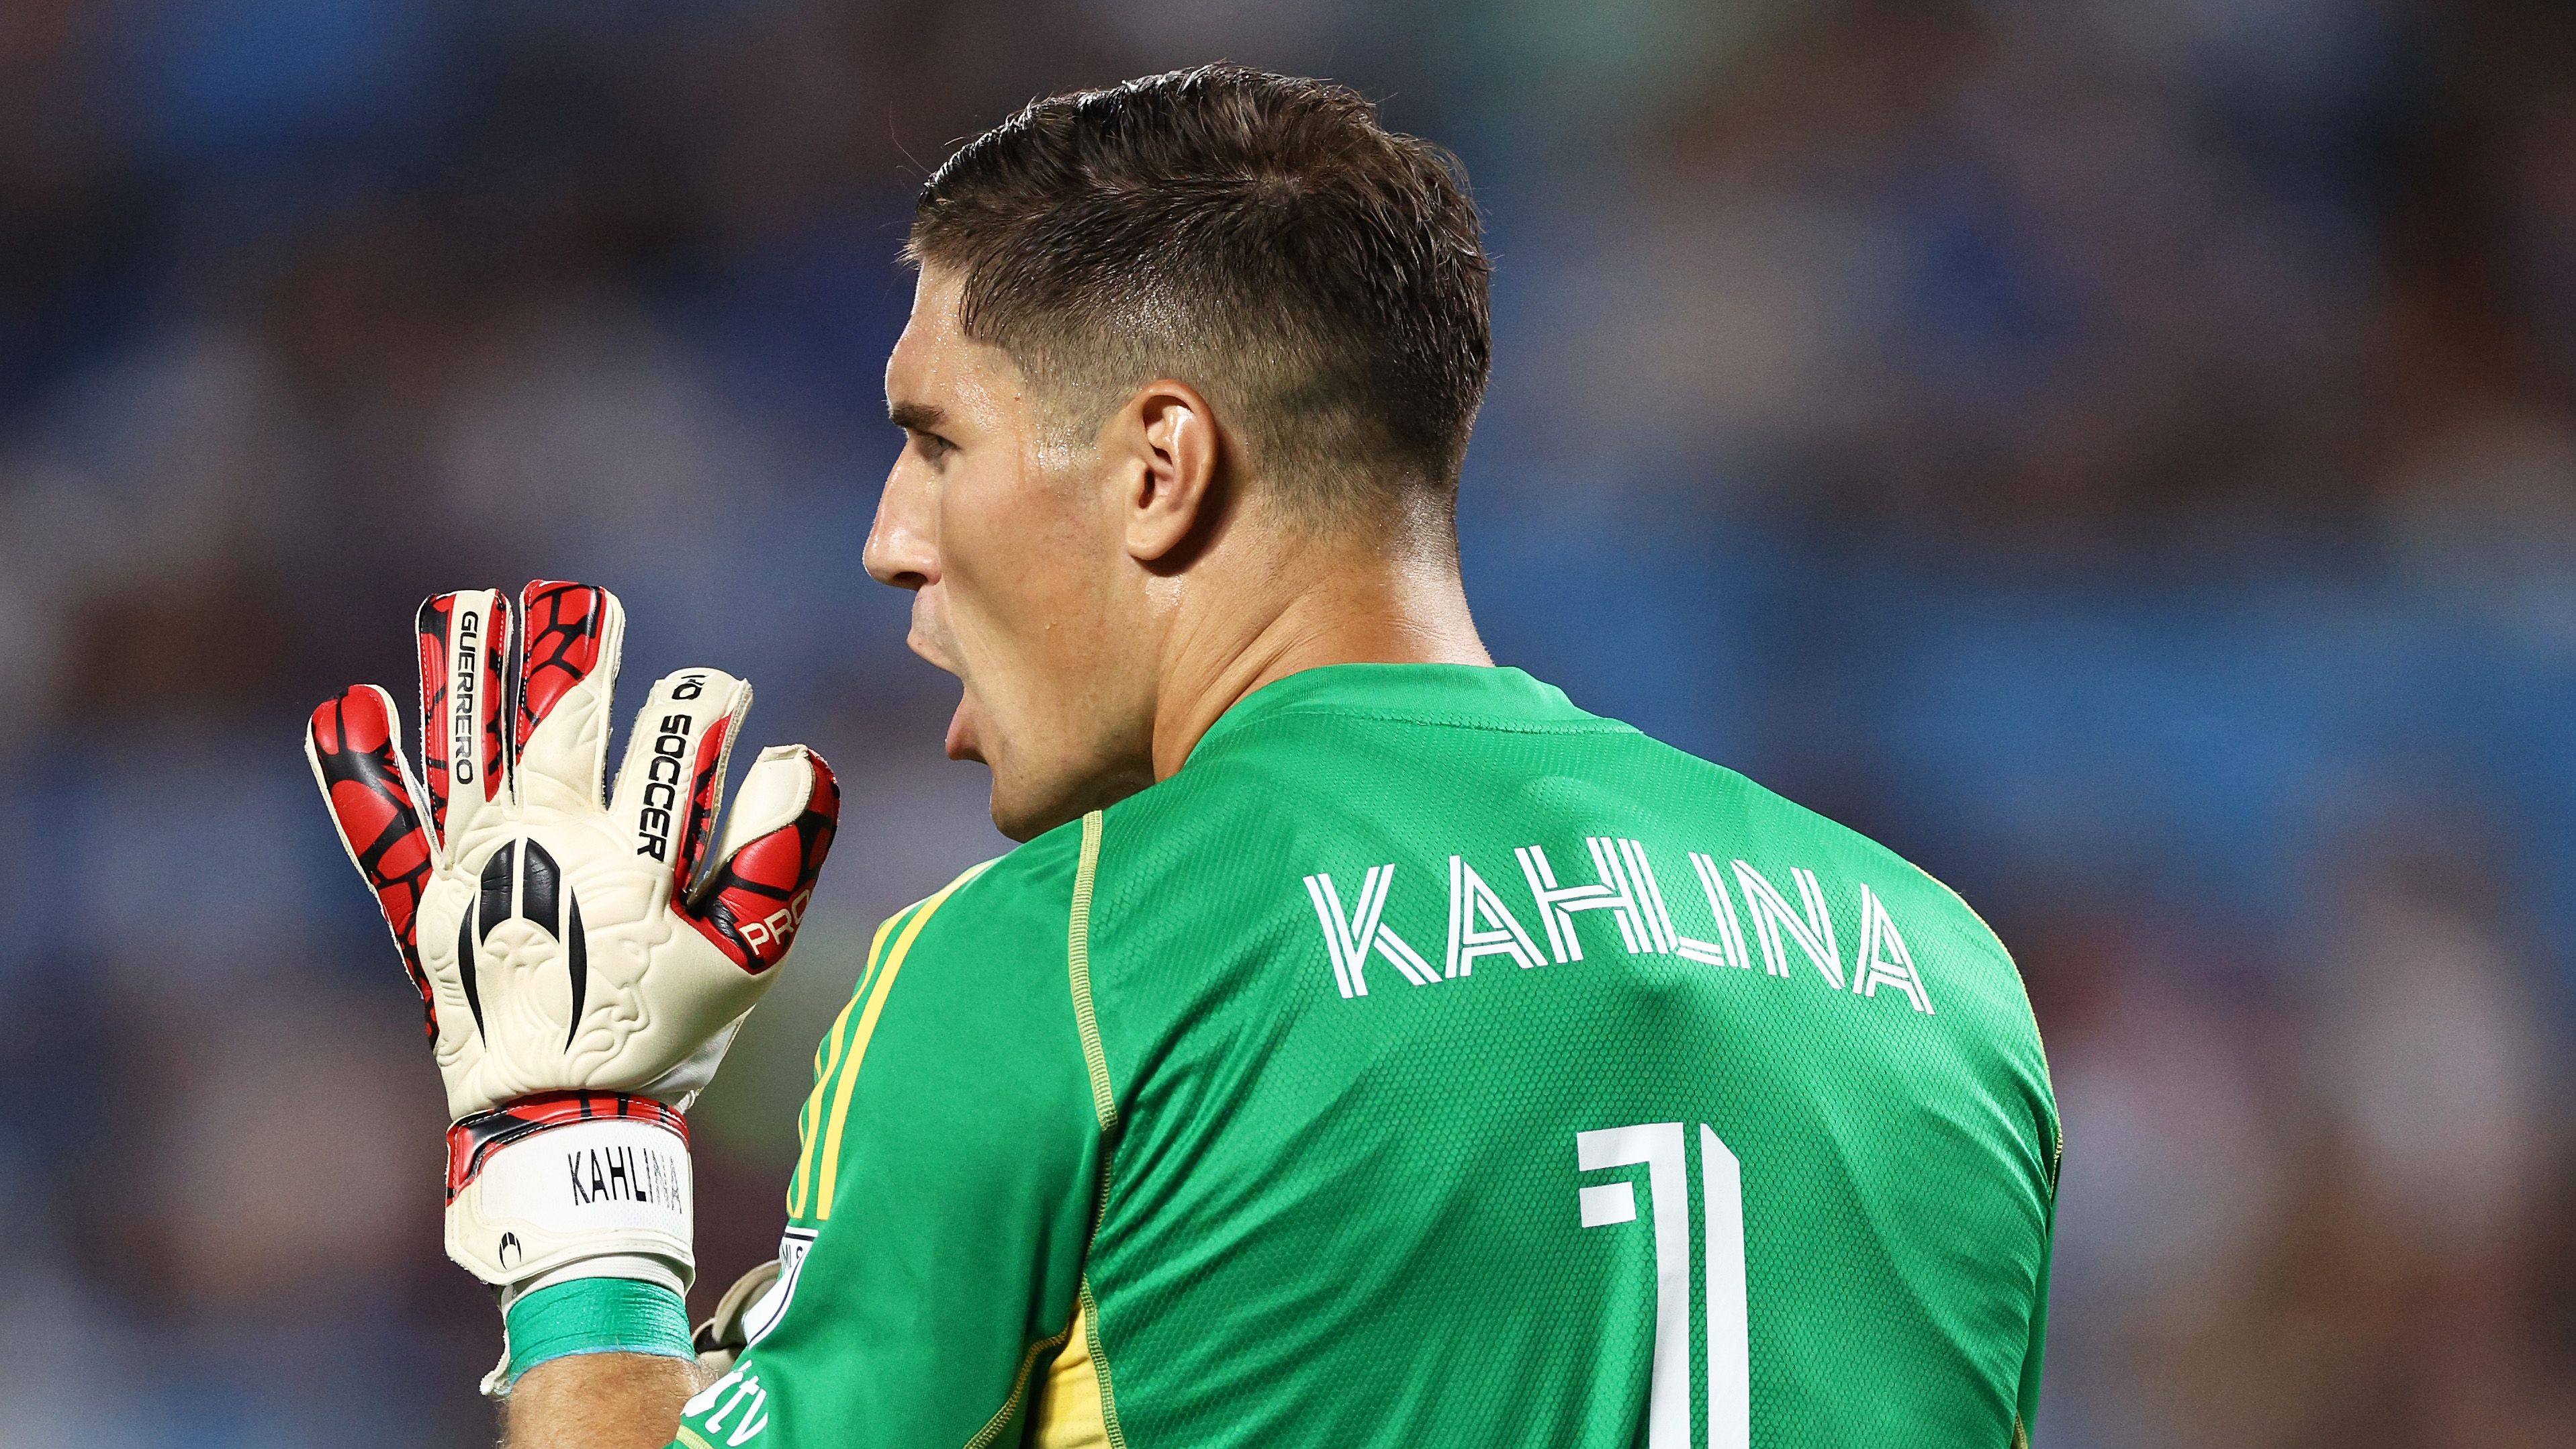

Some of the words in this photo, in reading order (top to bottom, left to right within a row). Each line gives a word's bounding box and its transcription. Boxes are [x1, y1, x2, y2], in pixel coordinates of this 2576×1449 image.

[455, 610, 479, 785] GUERRERO
[637, 714, 692, 862] SOCCER
[1303, 836, 1935, 1015] KAHLINA
[567, 1146, 682, 1214] KAHLINA
[1577, 1122, 1750, 1449] 1
